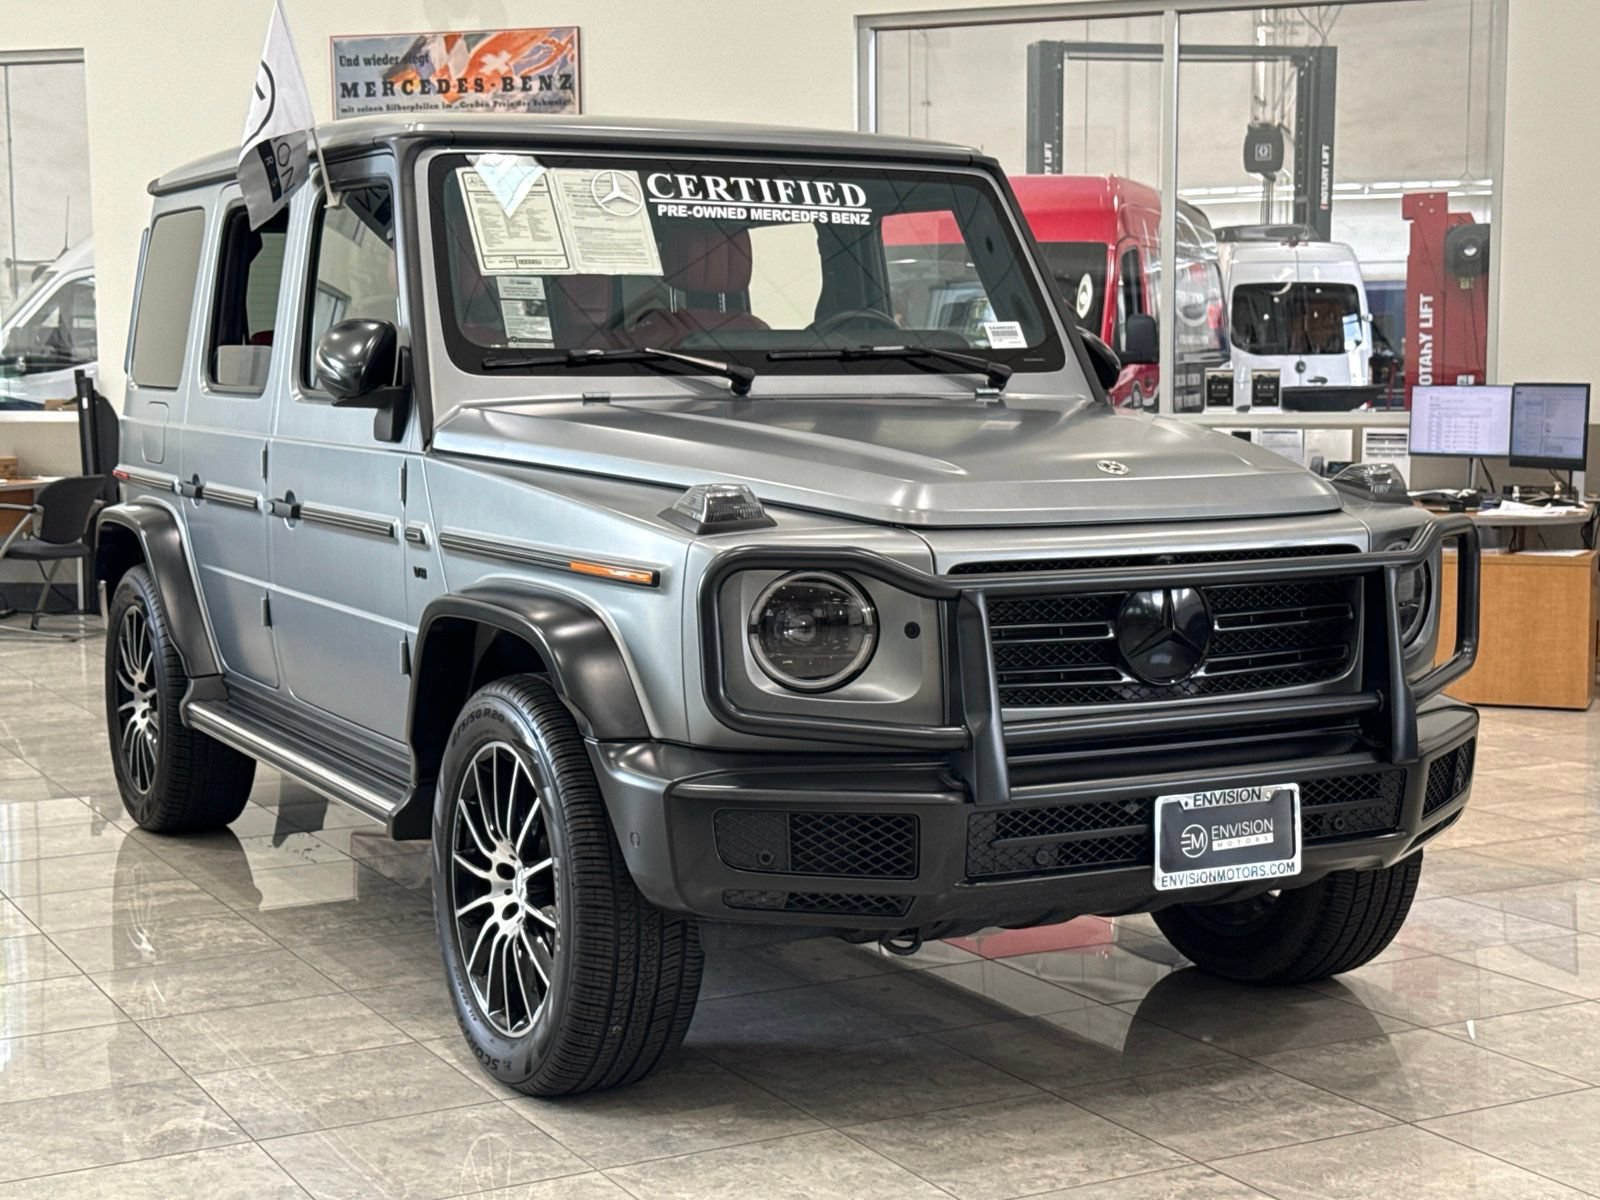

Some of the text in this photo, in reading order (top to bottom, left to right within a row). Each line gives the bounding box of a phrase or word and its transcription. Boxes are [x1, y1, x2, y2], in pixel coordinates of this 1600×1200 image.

[339, 55, 360, 67] Und
[363, 54, 400, 67] wieder
[340, 74, 572, 99] MERCEDES BENZ
[646, 172, 867, 208] CERTIFIED
[657, 204, 747, 220] PRE-OWNED
[831, 213, 871, 226] BENZ
[1418, 293, 1434, 328] LIFT
[1193, 787, 1262, 808] ENVISION
[1211, 817, 1274, 840] ENVISION
[1217, 836, 1269, 848] MOTORS
[1161, 861, 1296, 888] ENVISIONMOTORS.COM
